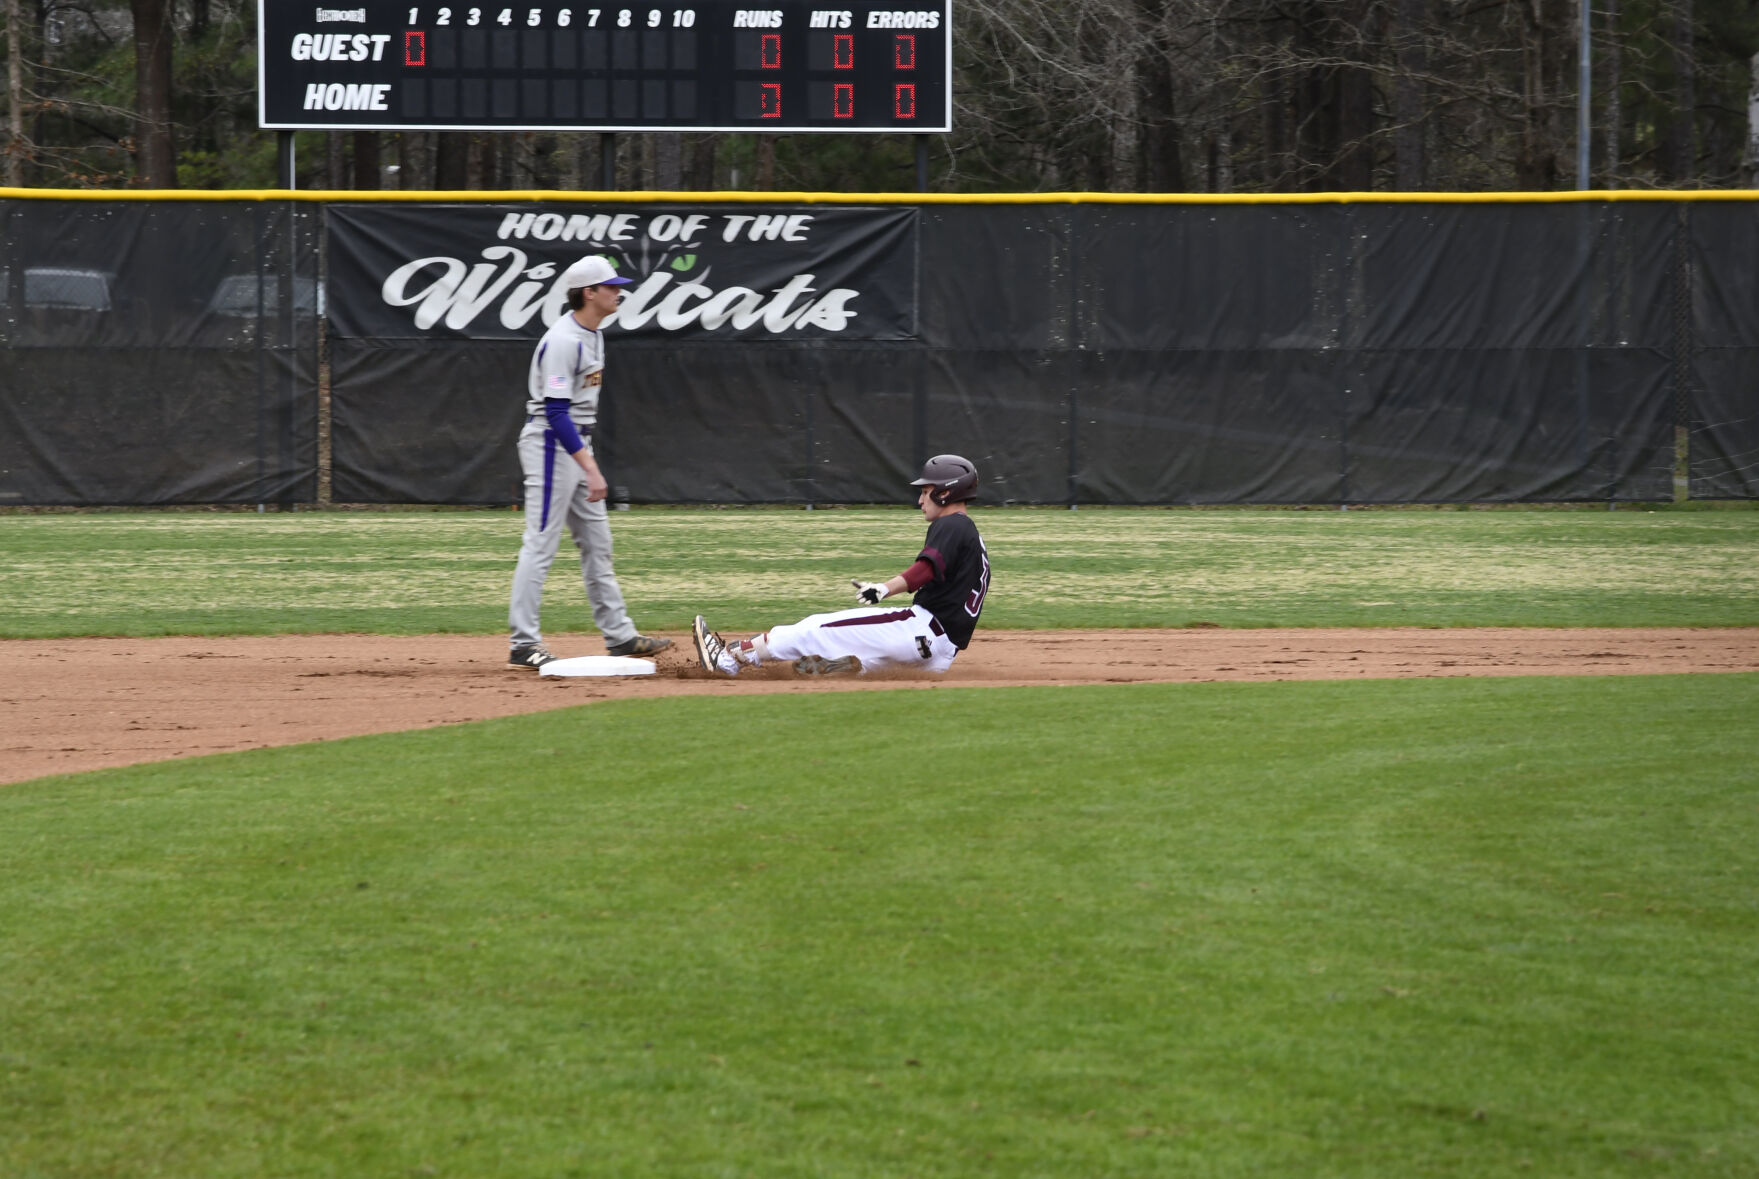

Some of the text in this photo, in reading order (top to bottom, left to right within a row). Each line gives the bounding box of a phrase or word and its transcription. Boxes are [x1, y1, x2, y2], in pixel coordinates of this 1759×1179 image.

[408, 7, 940, 29] 1 2 3 4 5 6 7 8 9 10 RUNS HITS ERRORS
[290, 33, 392, 61] GUEST
[405, 31, 915, 69] 0 0 0 0
[303, 83, 391, 111] HOME
[834, 83, 854, 118] 0
[896, 83, 915, 118] 0
[497, 212, 815, 242] HOME OF THE
